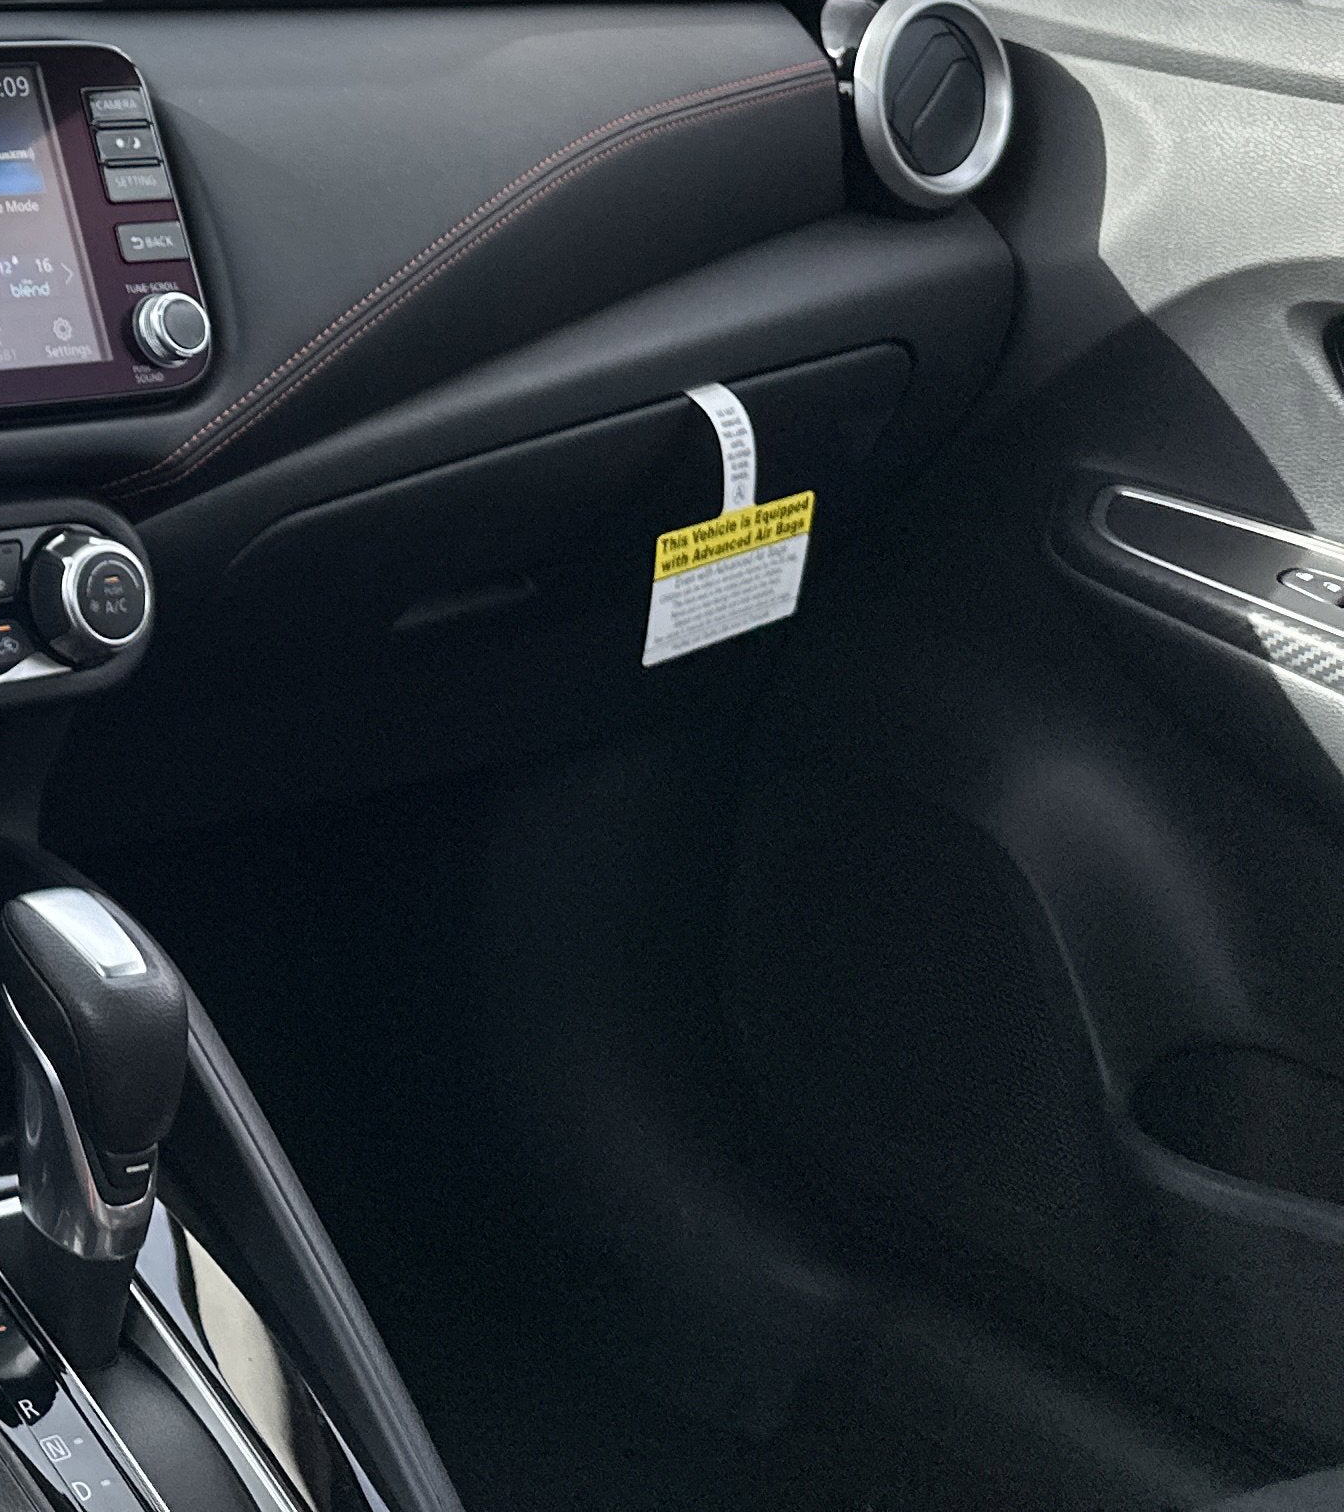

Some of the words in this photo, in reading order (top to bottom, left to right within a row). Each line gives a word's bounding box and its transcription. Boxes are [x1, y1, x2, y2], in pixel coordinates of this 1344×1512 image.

[6, 199, 40, 214] Mode
[144, 234, 174, 249] BACK
[35, 257, 53, 273] 16
[10, 282, 50, 298] blend
[45, 343, 93, 361] Settings
[662, 534, 688, 553] This
[692, 519, 737, 543] Vehicle
[754, 496, 810, 525] Equipped
[662, 552, 689, 572] with
[692, 533, 751, 563] Advanced
[754, 527, 772, 541] Air
[775, 518, 805, 536] Bags
[105, 599, 128, 614] A/C
[18, 1399, 40, 1419] R
[45, 1441, 65, 1458] N
[72, 1482, 91, 1501] D
